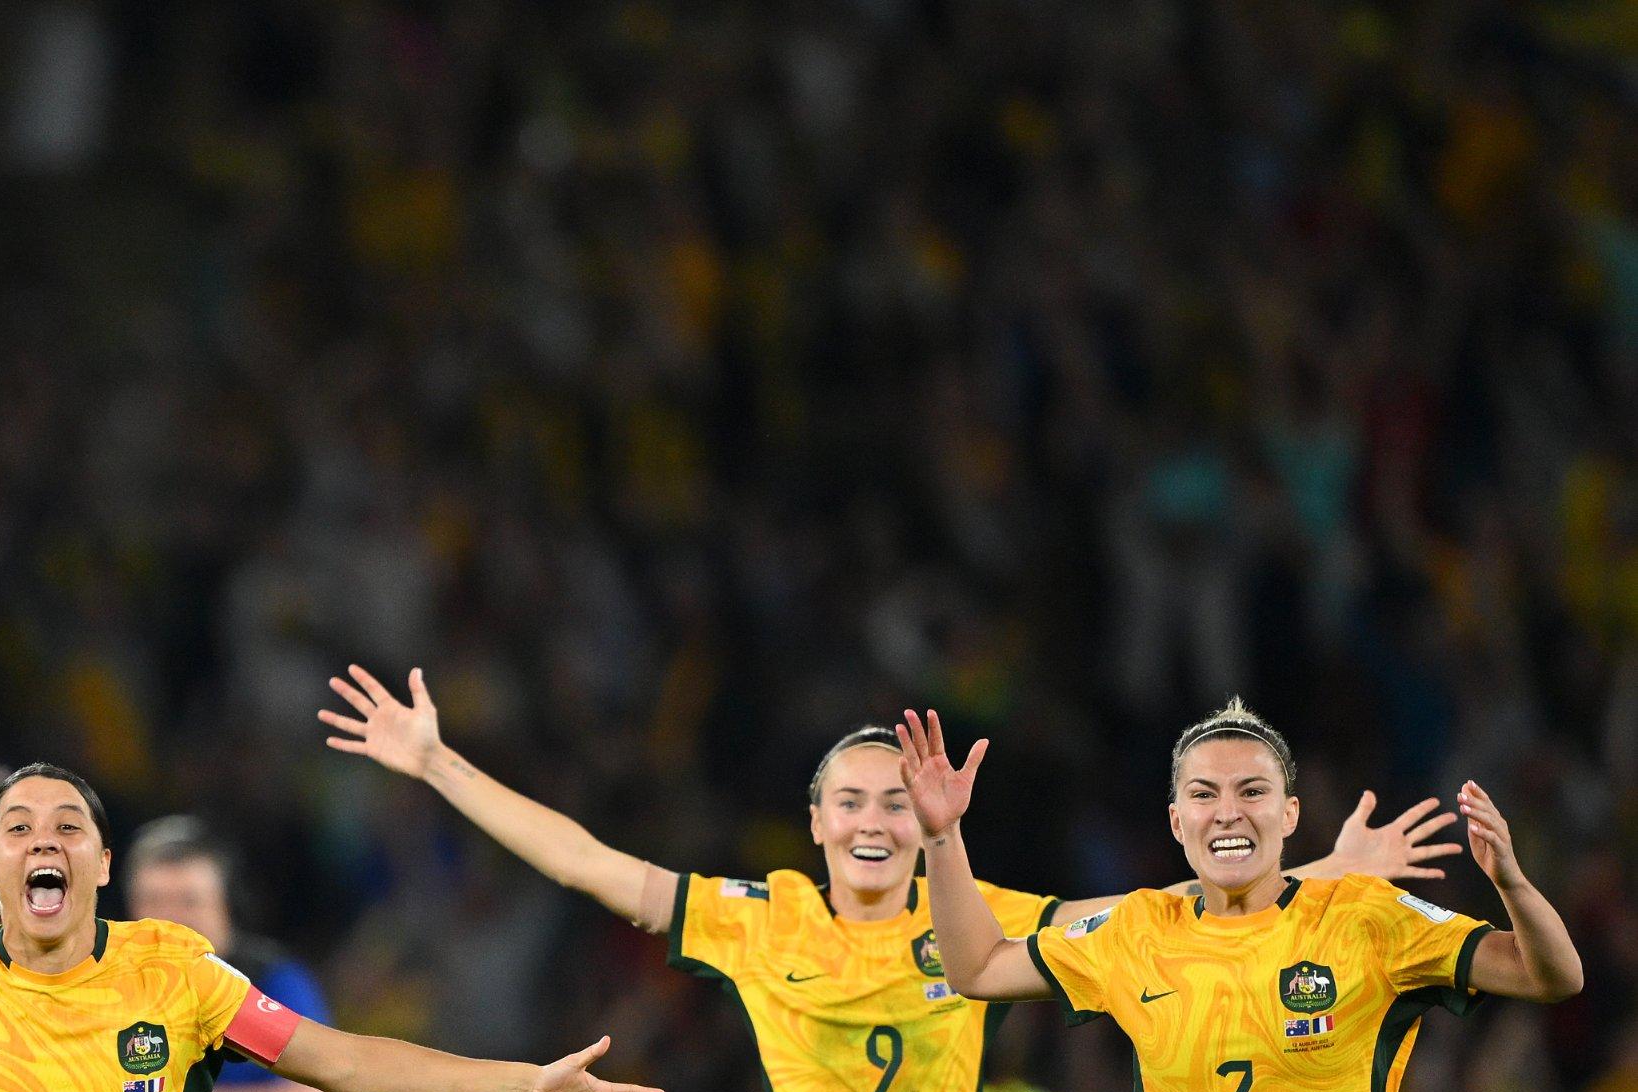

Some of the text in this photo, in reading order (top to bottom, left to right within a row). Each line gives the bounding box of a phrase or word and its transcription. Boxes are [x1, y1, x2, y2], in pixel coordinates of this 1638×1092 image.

[1290, 993, 1327, 1001] AUSTRALIA
[1311, 1042, 1335, 1051] AUSTRALIA
[128, 1053, 161, 1062] AUSTRALIA
